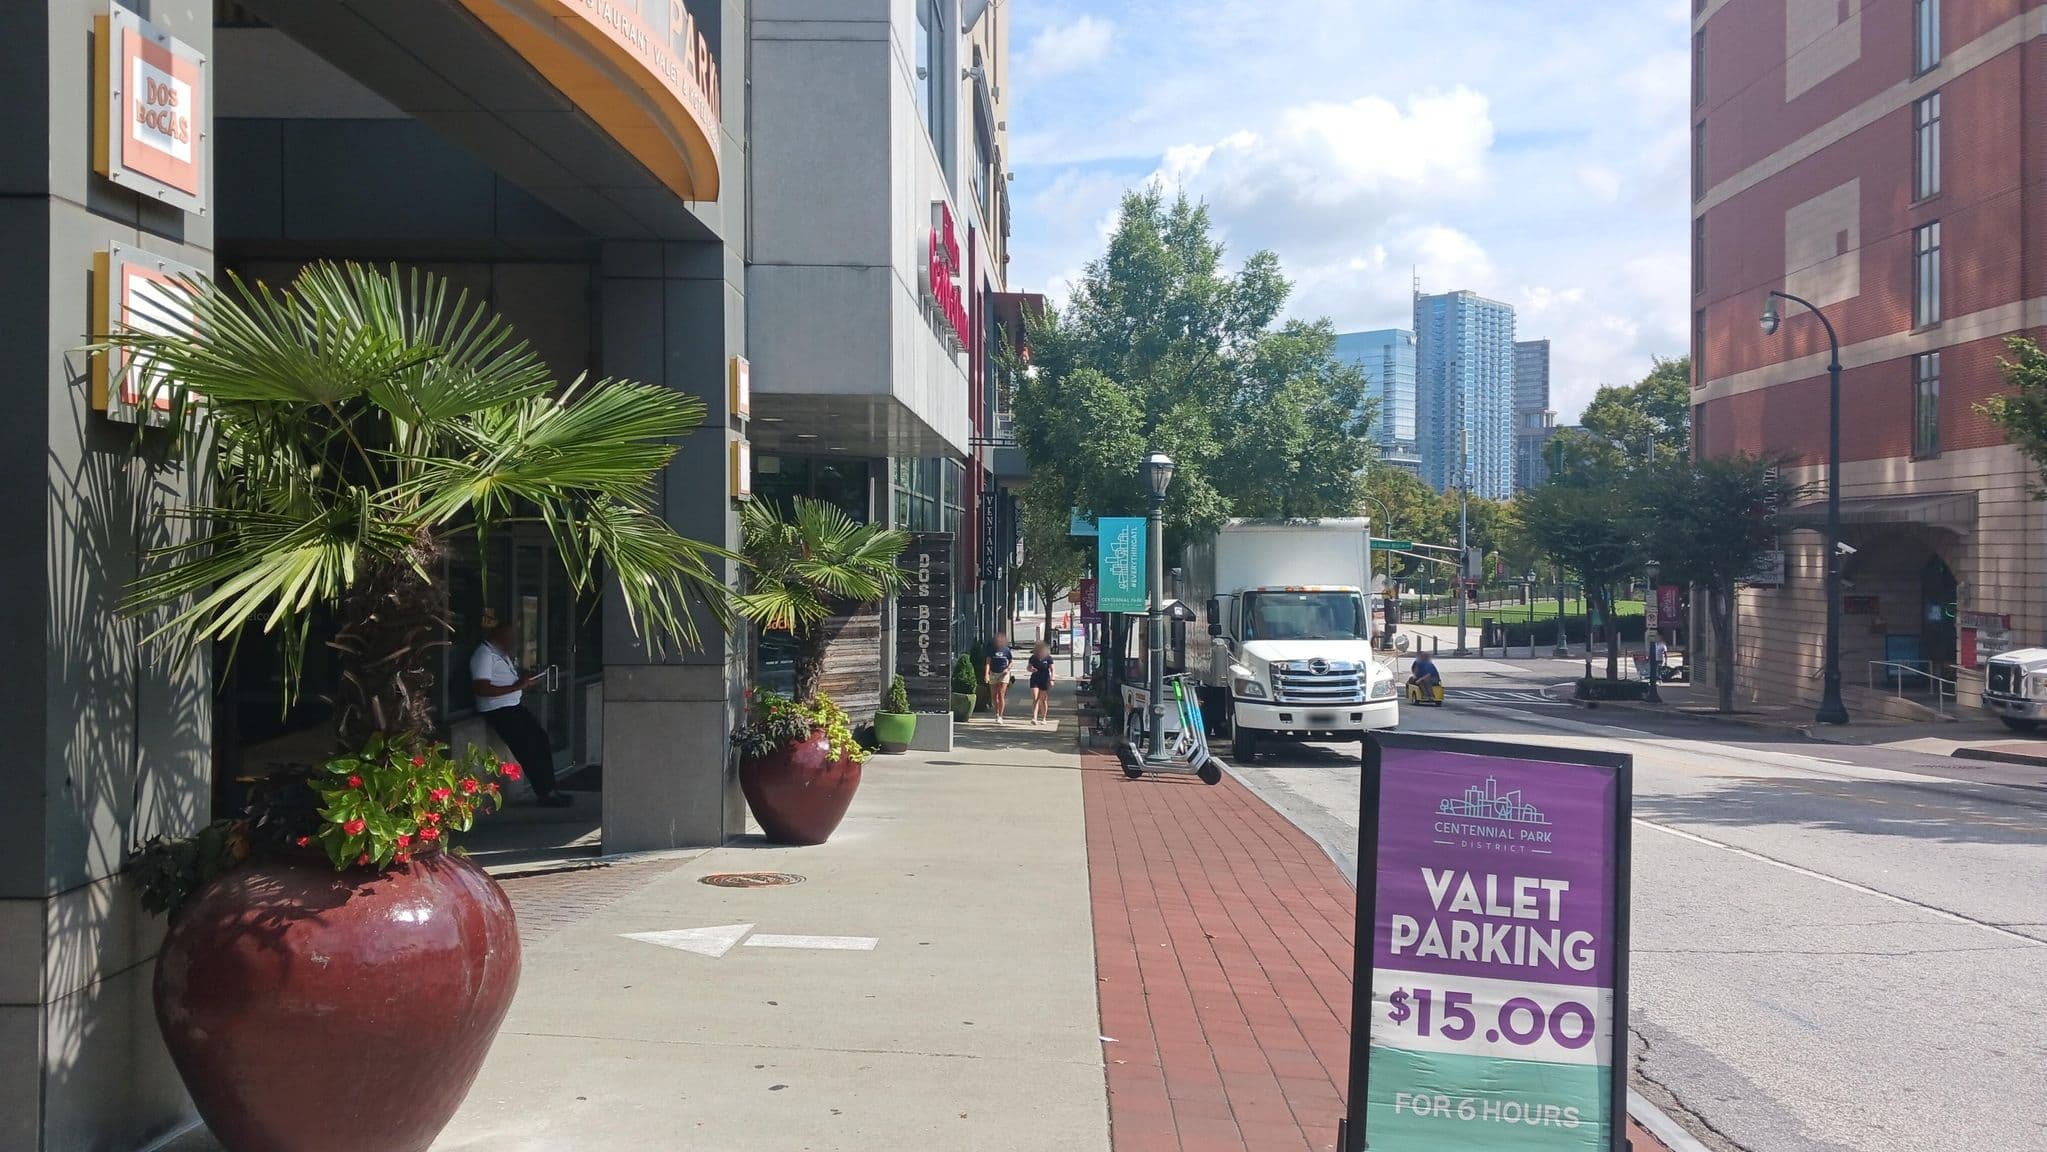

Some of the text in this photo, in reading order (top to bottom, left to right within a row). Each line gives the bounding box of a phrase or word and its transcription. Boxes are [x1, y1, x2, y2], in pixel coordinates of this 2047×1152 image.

[653, 45, 679, 87] VALET
[147, 77, 178, 107] DOS
[136, 99, 188, 144] BOCAS
[919, 553, 930, 597] DOS
[919, 605, 930, 676] BOCAS
[1434, 821, 1552, 843] CENTENNIAL PARK
[1461, 840, 1525, 852] DISTRICT
[1421, 867, 1569, 921] VALET
[1390, 914, 1596, 971] PARKING
[1387, 986, 1596, 1050] $15.00
[1395, 1092, 1580, 1128] FOR 6 HOURS
